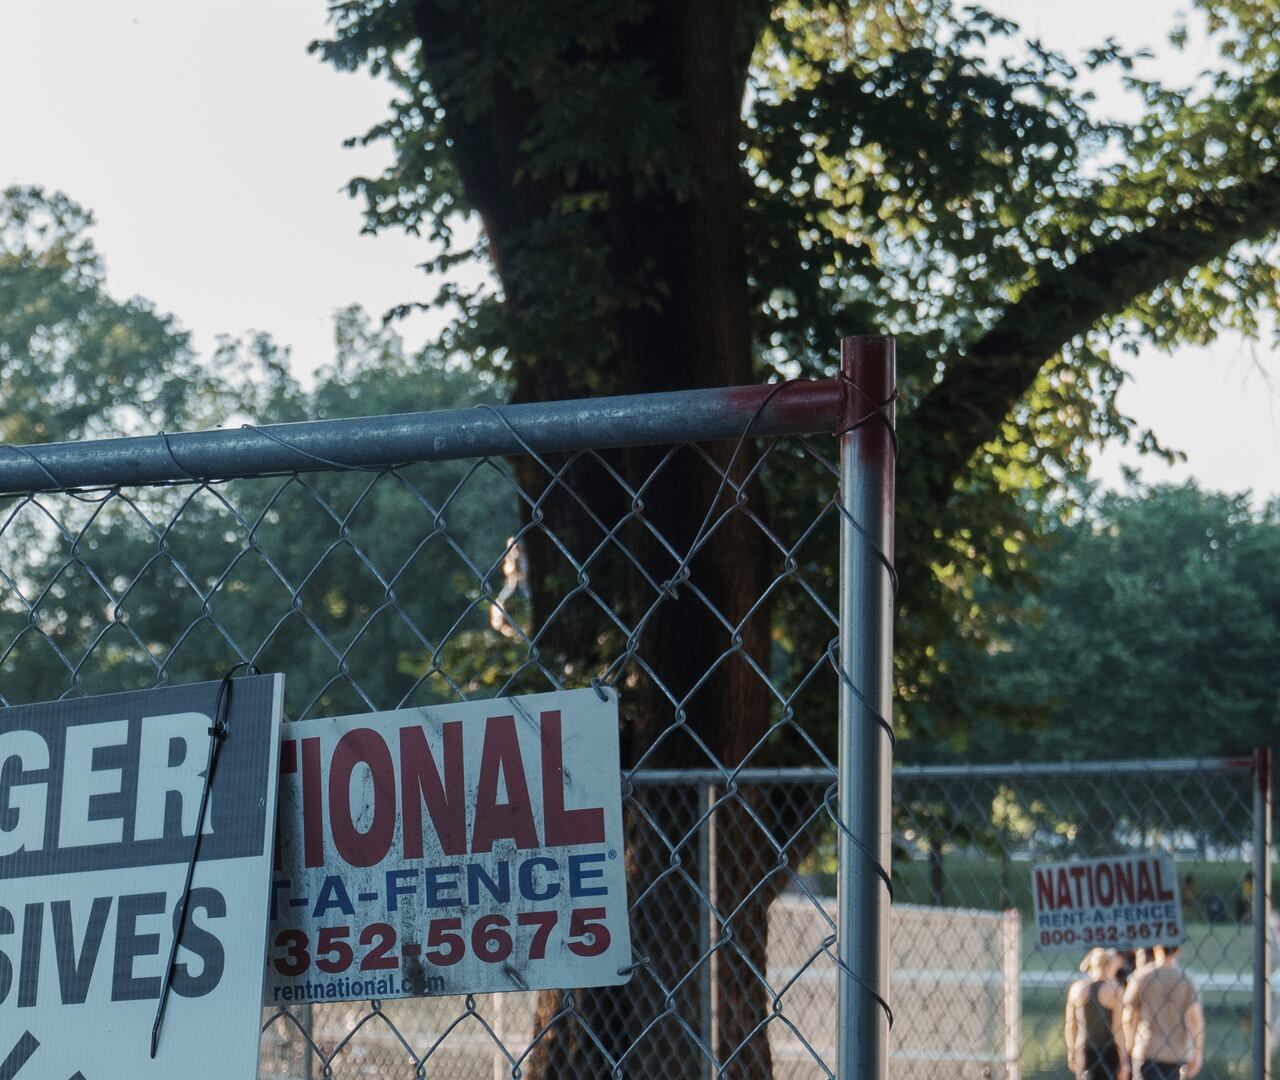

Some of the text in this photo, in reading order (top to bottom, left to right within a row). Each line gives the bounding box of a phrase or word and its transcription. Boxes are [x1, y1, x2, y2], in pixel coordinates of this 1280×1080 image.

[1035, 859, 1174, 912] NATIONAL
[1038, 904, 1177, 929] RENT-A-FENCE
[267, 906, 612, 977] 352-5675
[1039, 921, 1180, 946] 800-352-5675
[273, 974, 445, 1001] rentnational.cm
